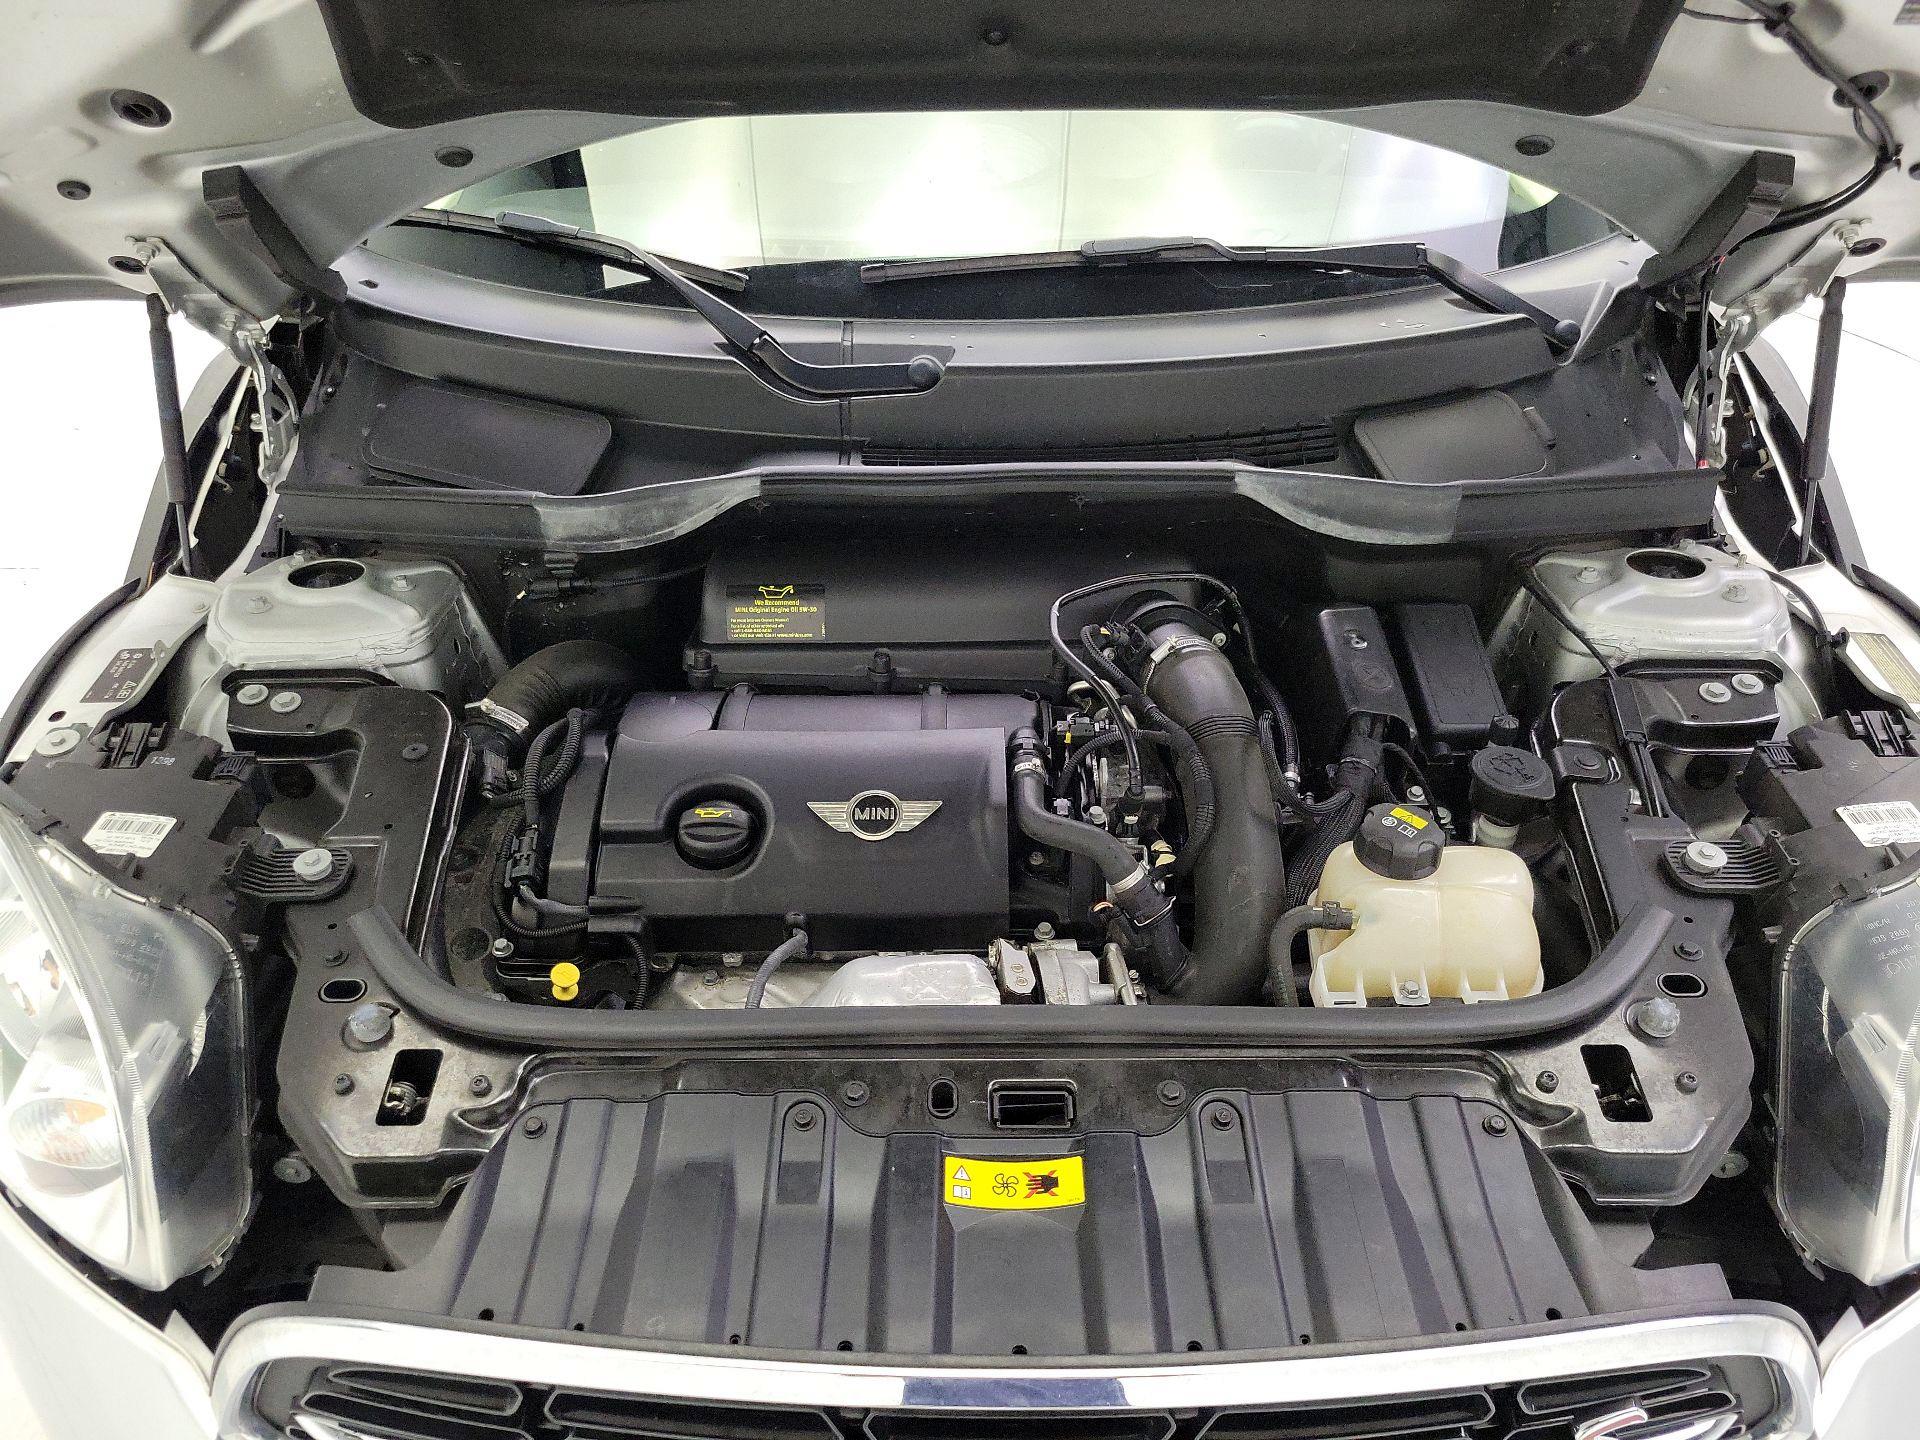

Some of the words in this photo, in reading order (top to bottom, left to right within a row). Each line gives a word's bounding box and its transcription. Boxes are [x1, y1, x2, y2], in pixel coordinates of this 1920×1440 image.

[749, 606, 770, 614] Original
[771, 606, 790, 614] Engine
[854, 807, 895, 821] MINI
